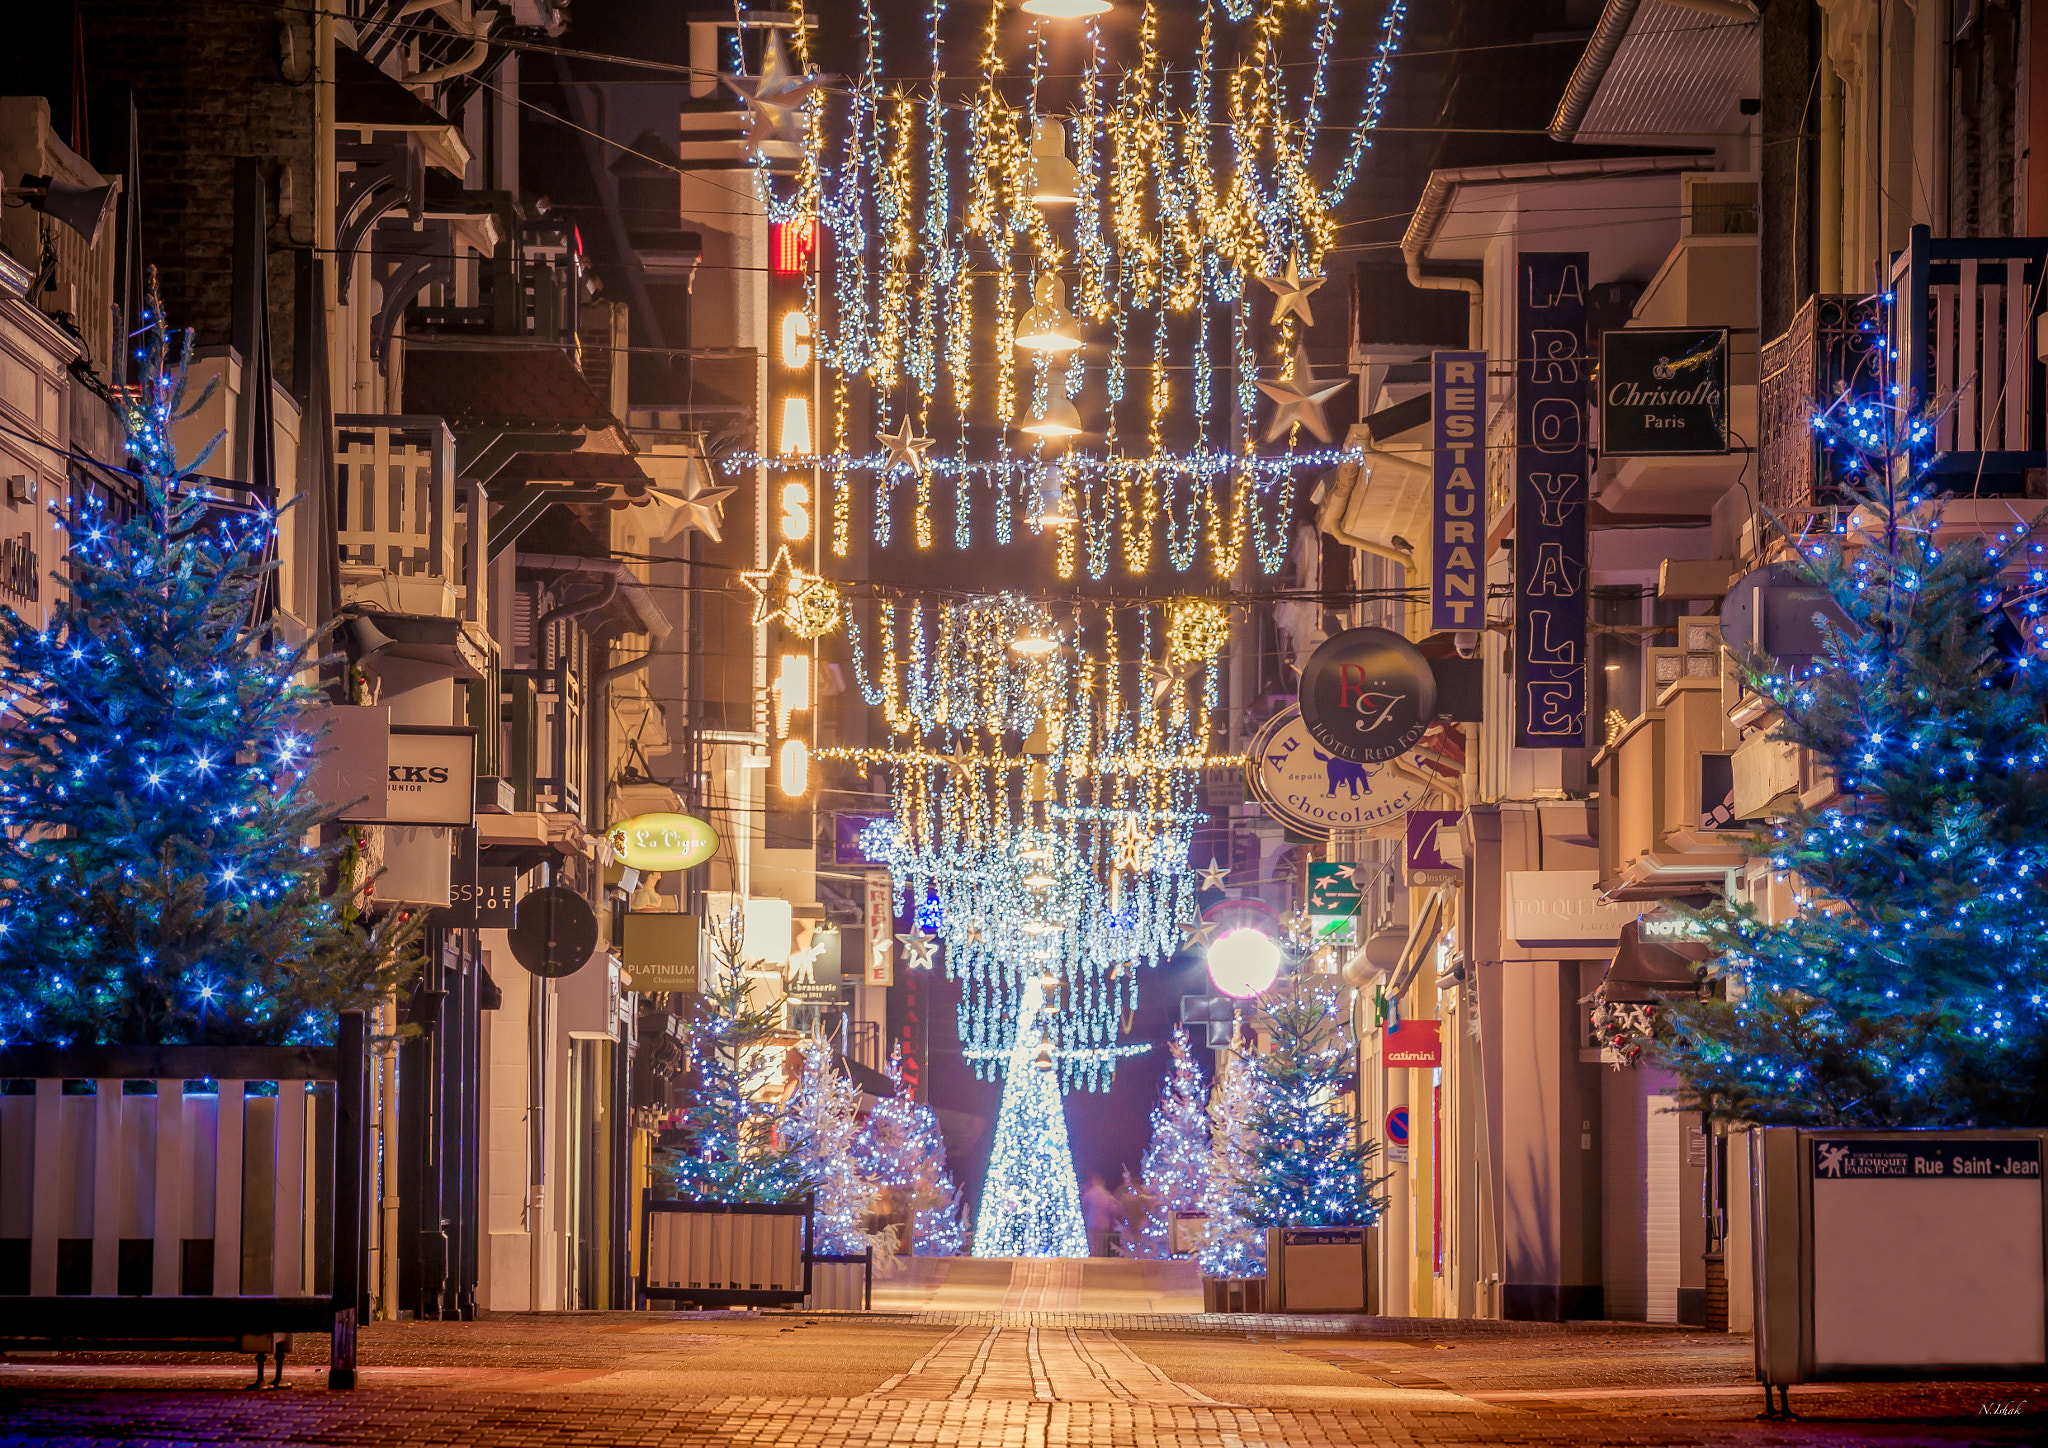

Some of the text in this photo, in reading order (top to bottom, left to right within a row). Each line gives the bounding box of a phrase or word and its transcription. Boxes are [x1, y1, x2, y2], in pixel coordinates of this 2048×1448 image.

[1528, 264, 1584, 308] LA
[1607, 380, 1720, 407] Christofle
[1644, 414, 1686, 430] Paris
[1444, 360, 1476, 624] RESTAURANT
[1527, 329, 1581, 735] ROYALE
[1267, 735, 1301, 773] Au
[1364, 745, 1396, 761] RED
[1398, 722, 1425, 748] FOX
[1288, 772, 1323, 781] depuis
[1287, 789, 1413, 823] chocolatier
[635, 829, 707, 855] La Vigne
[1645, 921, 1685, 935] NOT
[628, 964, 695, 975] PLATINIUM
[652, 976, 695, 984] Chaussures
[1388, 1051, 1435, 1061] catimini
[1914, 1156, 1944, 1175] Rue
[1953, 1156, 1992, 1175] Saint
[2003, 1157, 2039, 1175] Jean
